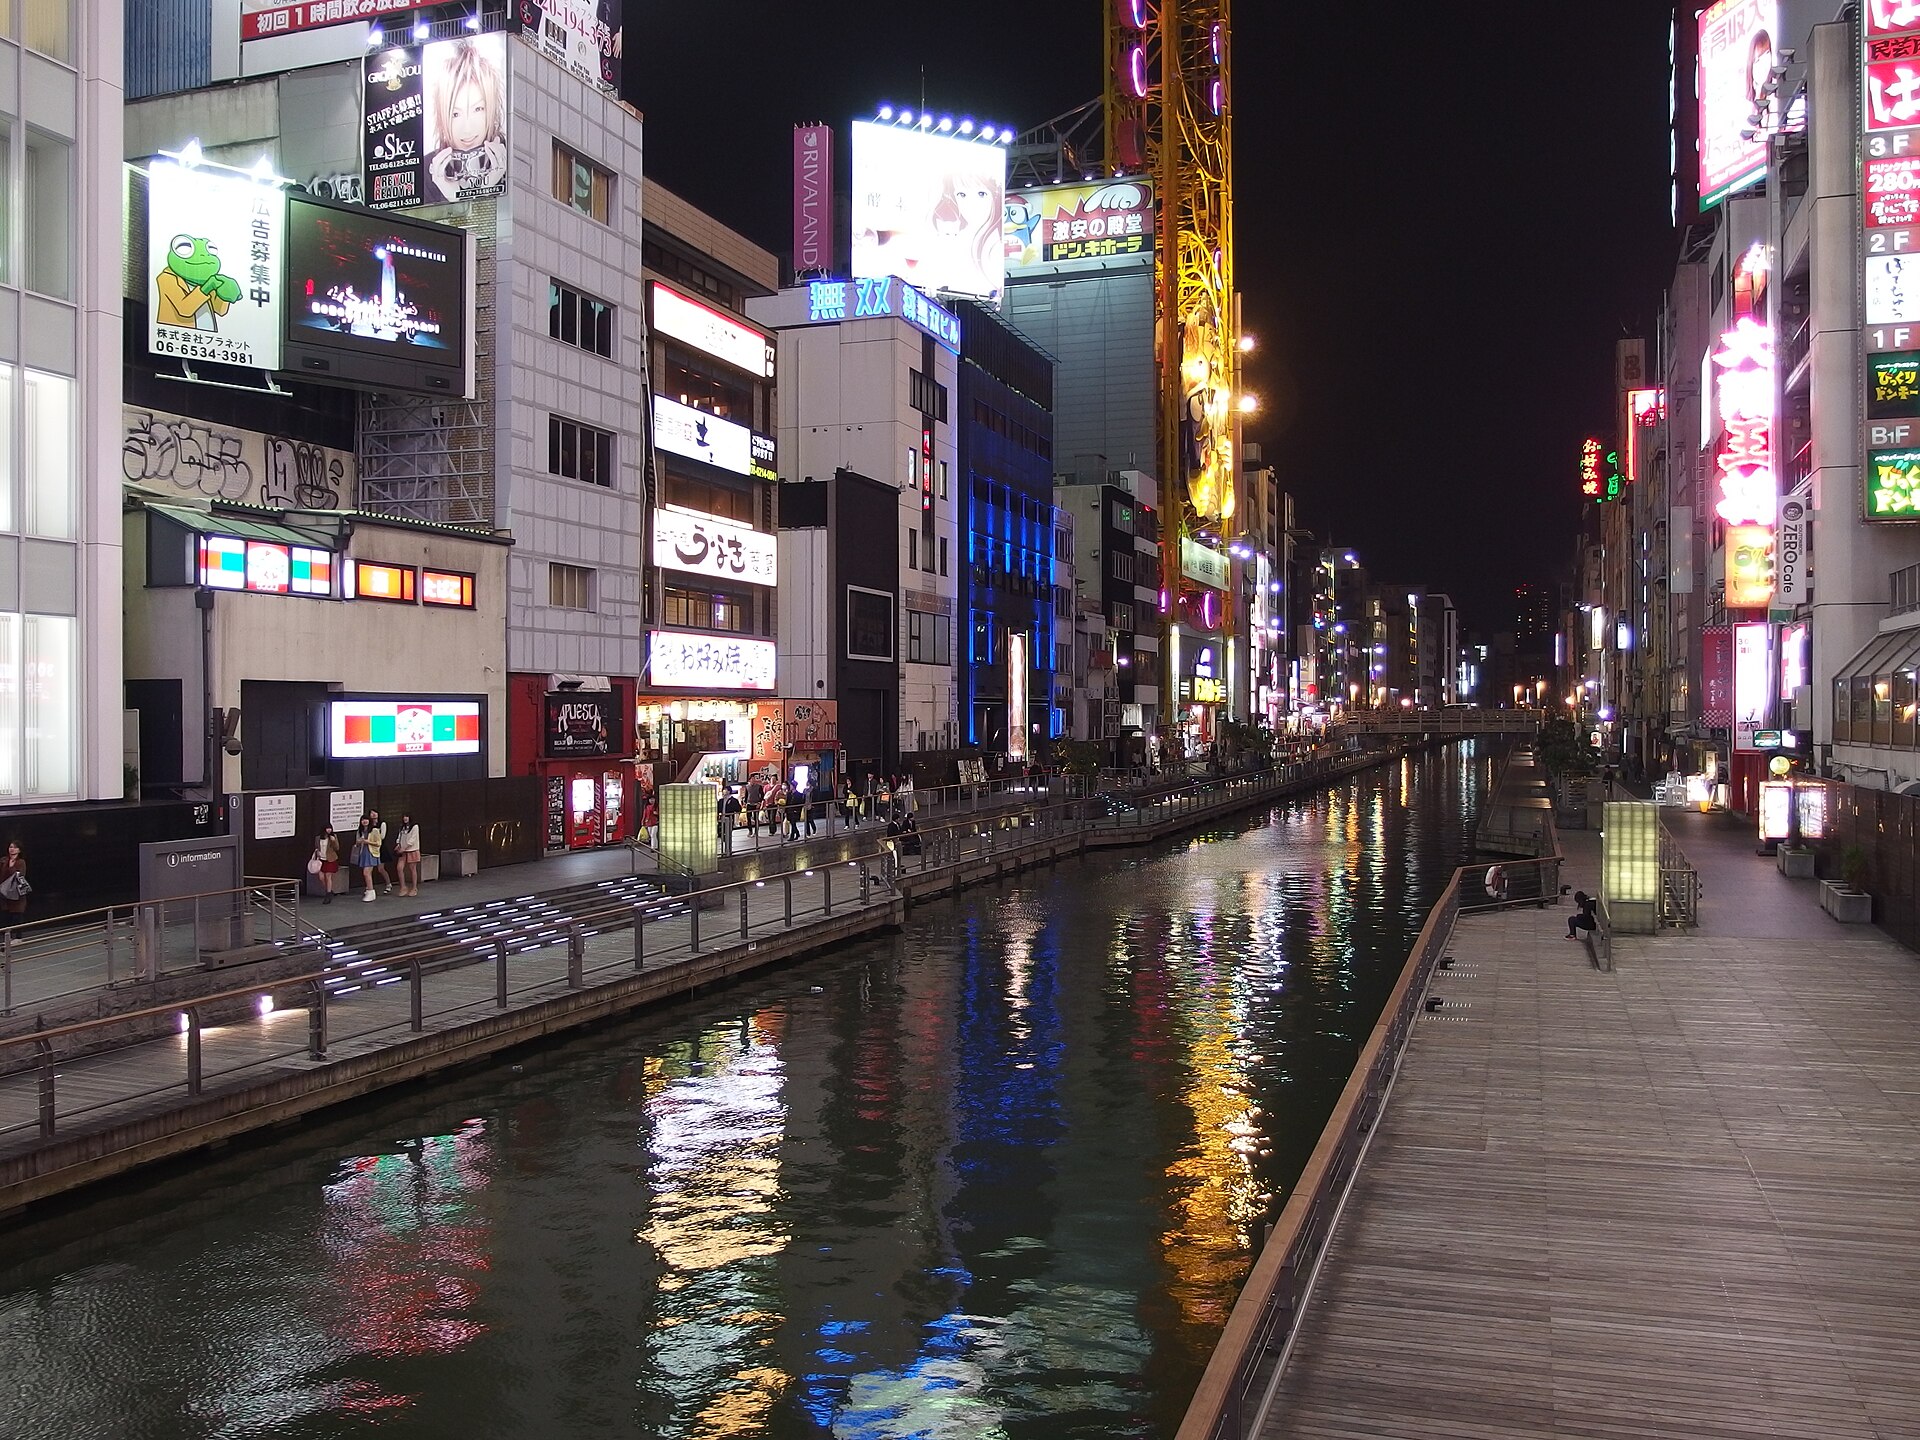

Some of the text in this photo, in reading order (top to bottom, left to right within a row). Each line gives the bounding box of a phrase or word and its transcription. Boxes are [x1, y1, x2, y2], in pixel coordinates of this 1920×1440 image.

[385, 133, 415, 160] Sky
[803, 150, 818, 266] RIVALAND
[1052, 213, 1143, 241] 激安の殿堂
[250, 198, 271, 308] 広告募集中
[810, 277, 892, 321] 無双
[156, 327, 251, 351] 株式会社プラネット
[156, 341, 253, 365] 06-6534-3981
[1877, 370, 1917, 386] びっくり
[1875, 385, 1919, 401] ドンキー
[1871, 425, 1910, 445] B1F
[1583, 439, 1598, 494] お好み焼
[1783, 524, 1798, 564] ZERO
[180, 851, 222, 863] information
